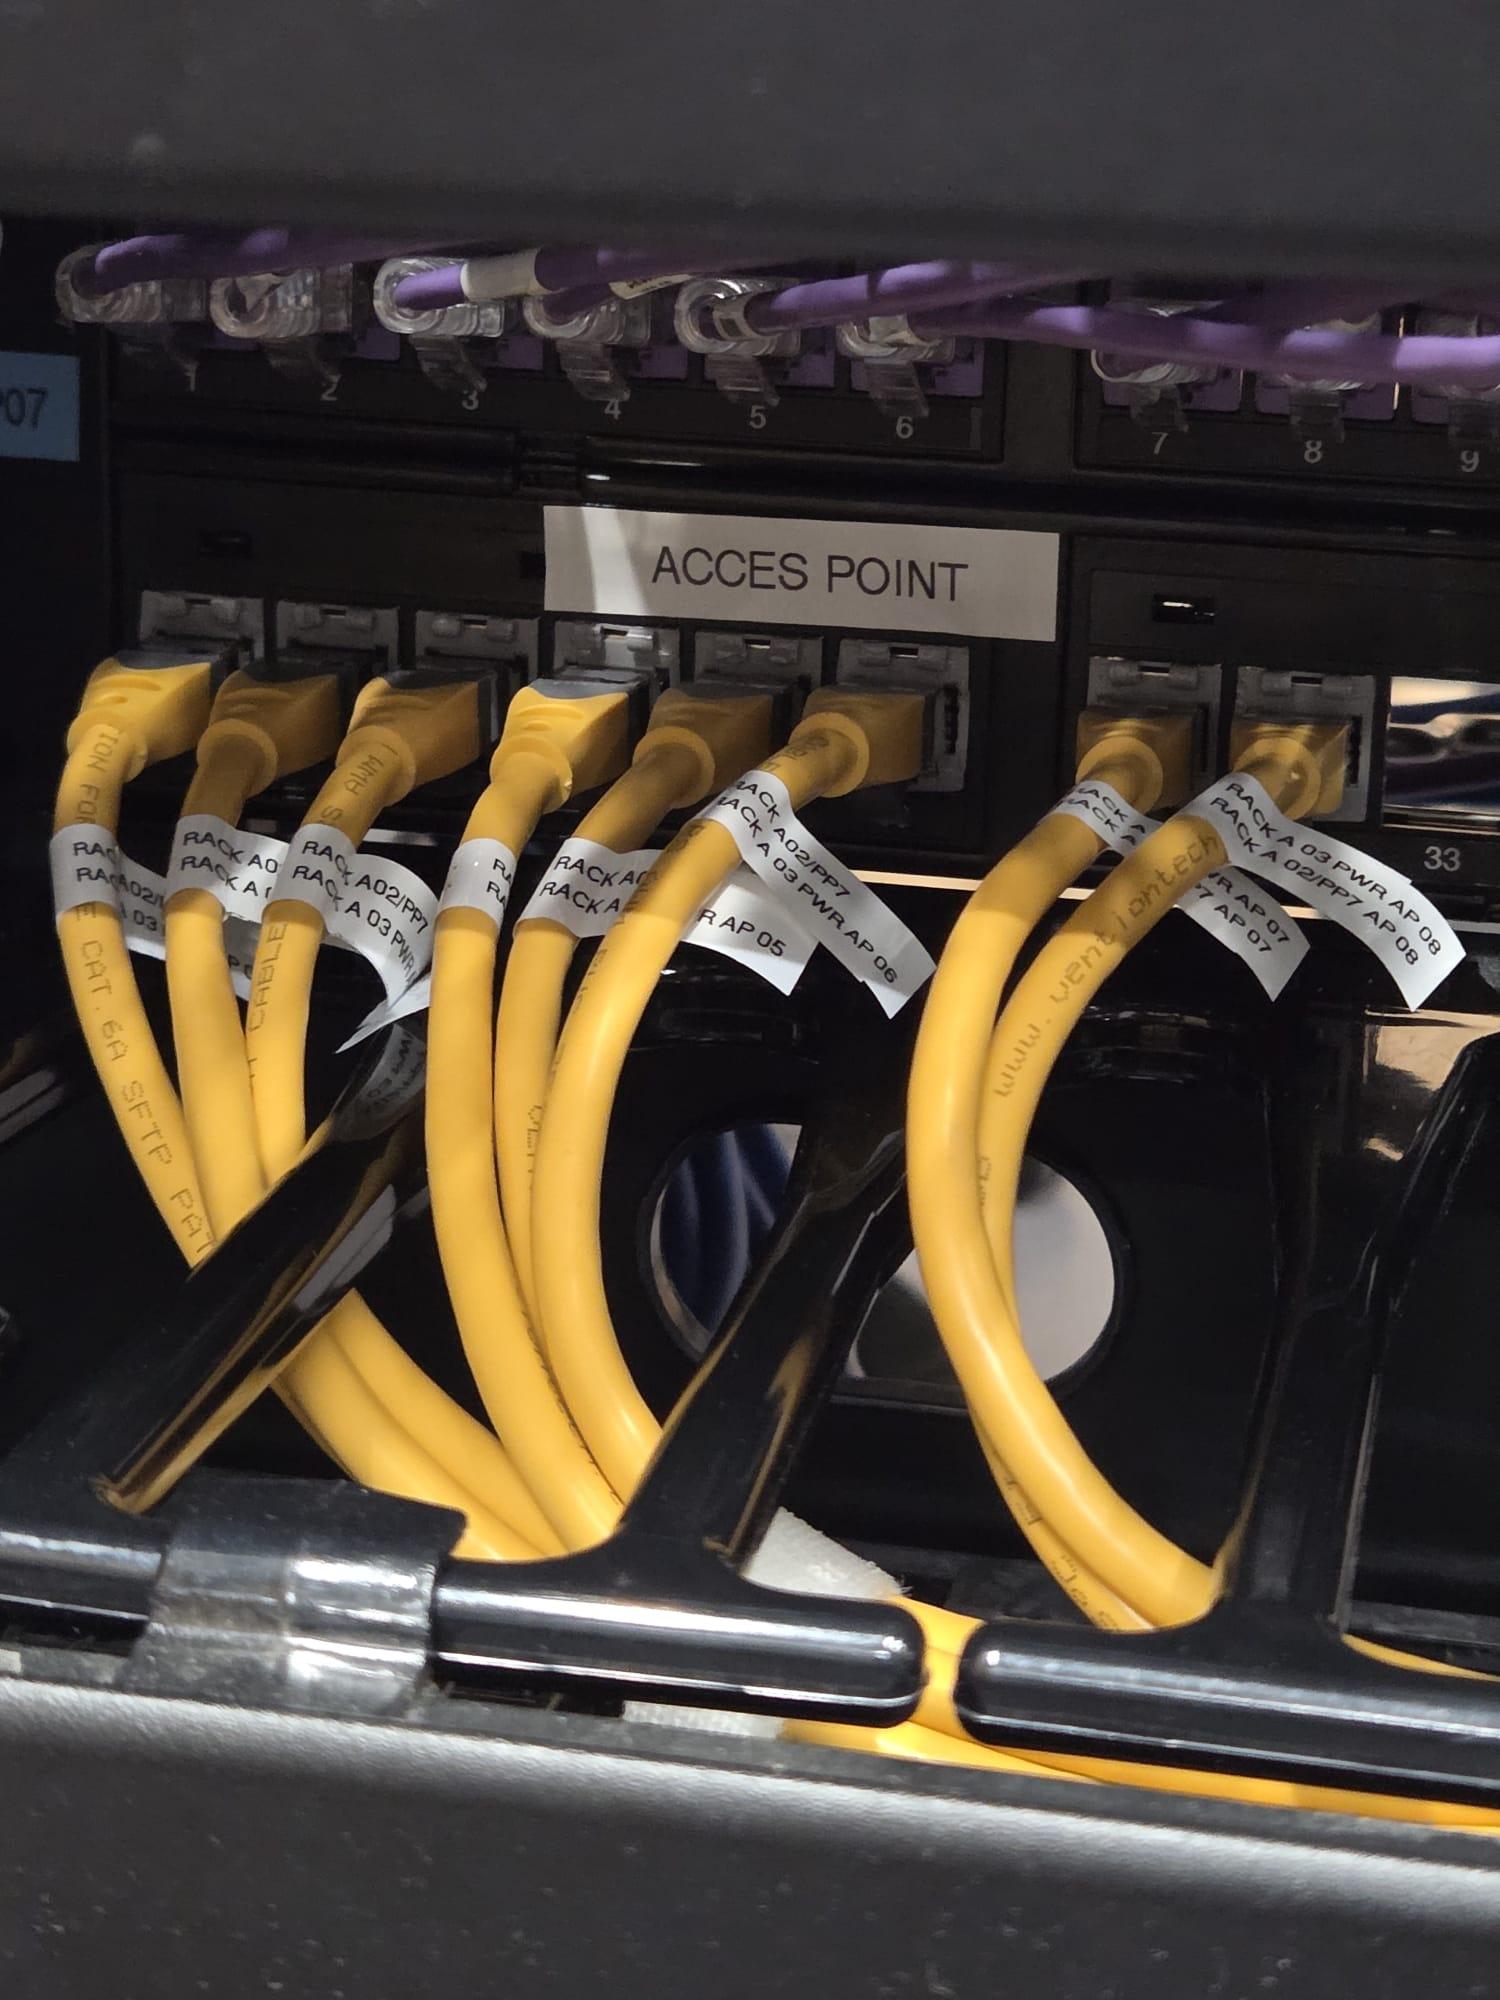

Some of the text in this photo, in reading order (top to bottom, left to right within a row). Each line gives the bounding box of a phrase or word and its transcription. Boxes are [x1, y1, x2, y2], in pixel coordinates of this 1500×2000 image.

[320, 374, 339, 400] 2
[462, 389, 480, 411] 3
[0, 387, 49, 432] 07
[603, 400, 622, 421] 4
[749, 406, 767, 430] 5
[895, 415, 914, 439] 6
[1152, 431, 1169, 456] 7
[1303, 440, 1324, 464] 8
[1460, 450, 1480, 473] 9
[651, 546, 969, 601] ACCES POINT
[183, 831, 244, 865] RACK
[301, 840, 354, 886] RACK
[1423, 845, 1462, 872] 33
[180, 855, 239, 891] RACK
[553, 855, 620, 888] RACK
[1210, 796, 1262, 854] RACK
[1362, 909, 1398, 934] AP
[1395, 935, 1420, 967] 08
[1225, 782, 1442, 957] RACK A 03 PWR AP 08
[292, 864, 344, 912] RACK
[345, 901, 361, 919] A
[366, 909, 393, 937] 03
[538, 881, 608, 915] RACK
[756, 841, 772, 858] A
[772, 857, 800, 885] 03
[797, 881, 847, 931] PWR
[843, 928, 875, 954] AP
[873, 954, 899, 985] 06
[1213, 902, 1247, 928] AP
[1246, 928, 1273, 954] 07
[1234, 893, 1267, 918] AP
[1265, 918, 1291, 944] 07
[718, 915, 756, 936] AP
[755, 930, 787, 958] 05
[120, 1079, 174, 1166] SFTP
